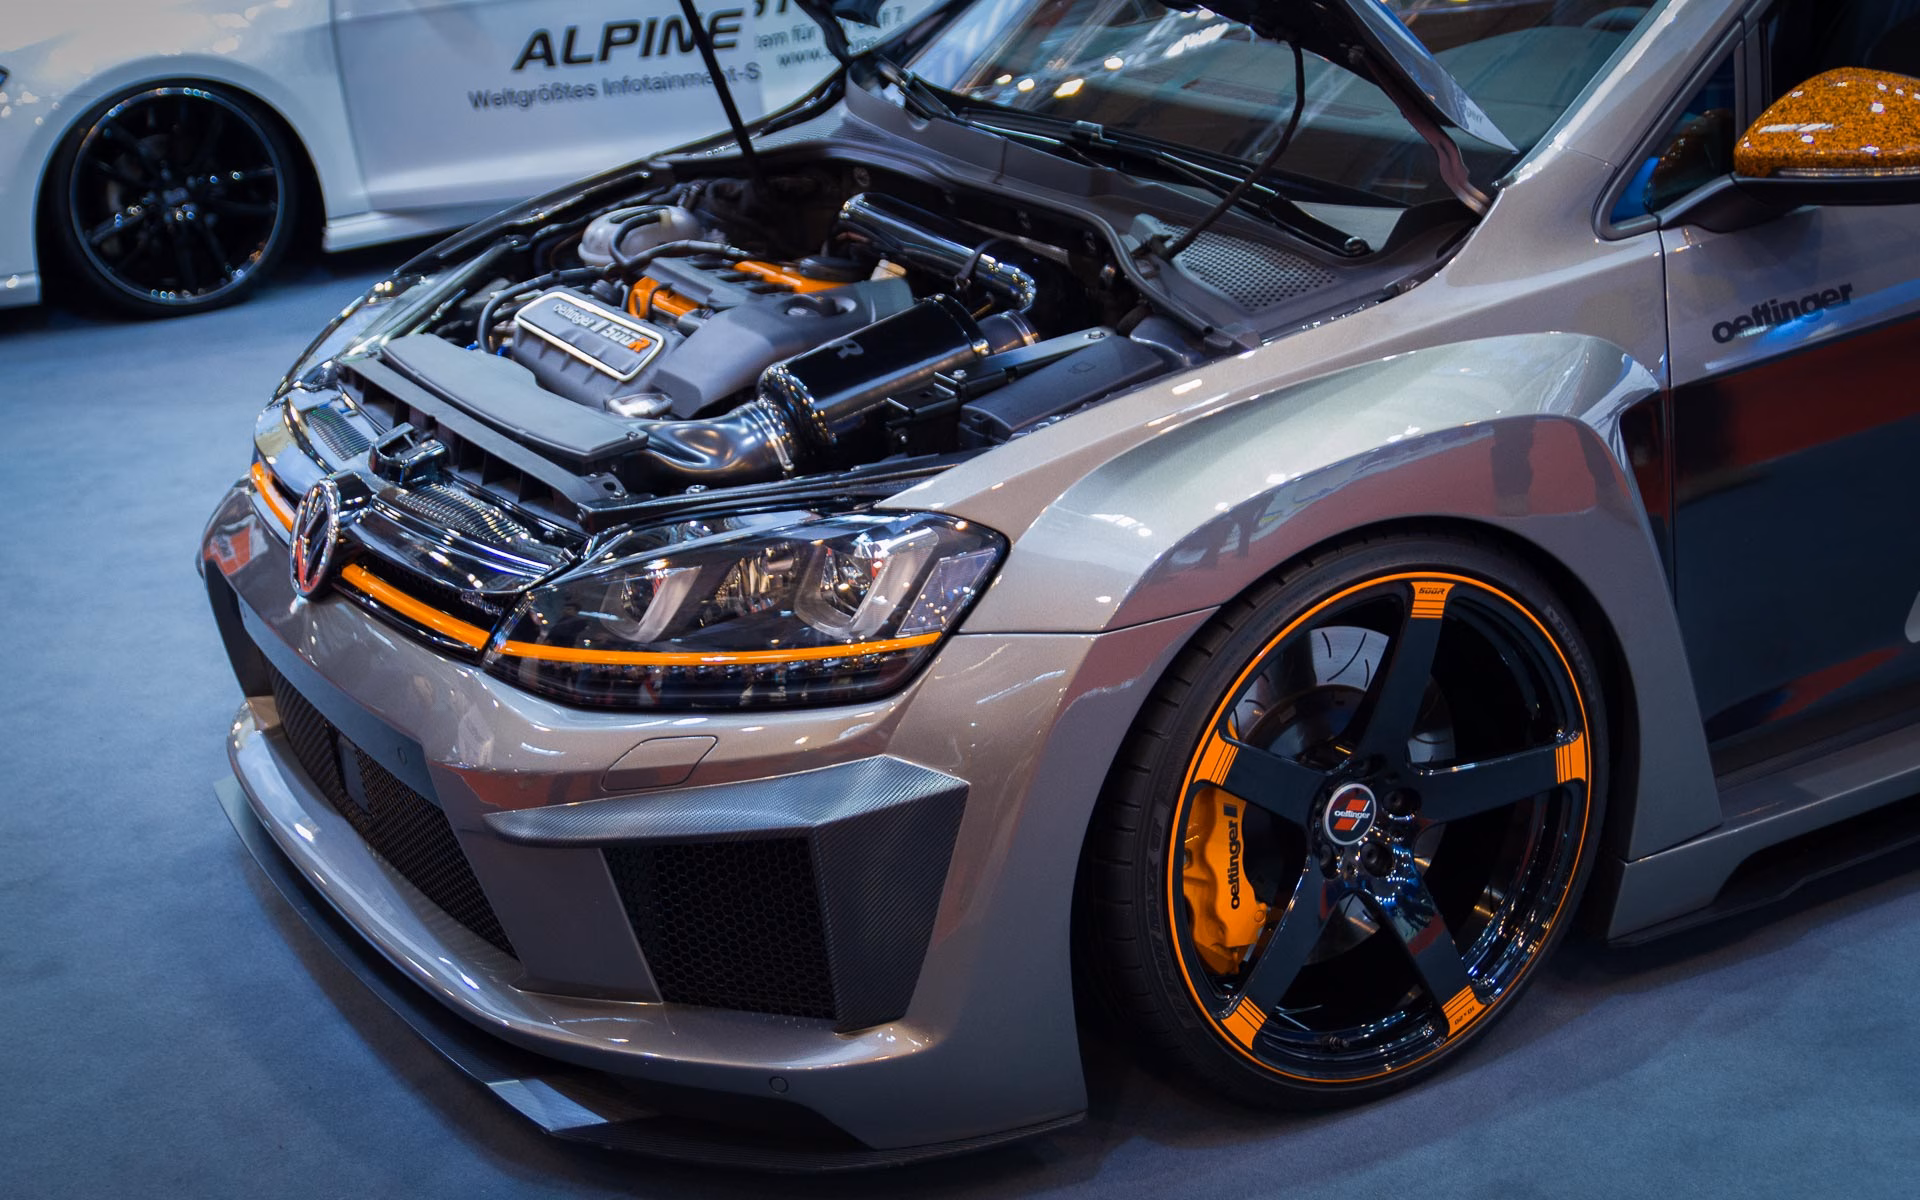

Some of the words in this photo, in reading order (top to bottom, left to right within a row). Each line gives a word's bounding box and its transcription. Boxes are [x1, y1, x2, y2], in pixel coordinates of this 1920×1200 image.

[512, 8, 745, 70] ALPINE
[468, 82, 598, 110] Weltgrößtes
[1712, 283, 1853, 344] oettinger
[1334, 809, 1371, 820] oettinger
[1227, 820, 1241, 910] oettinger
